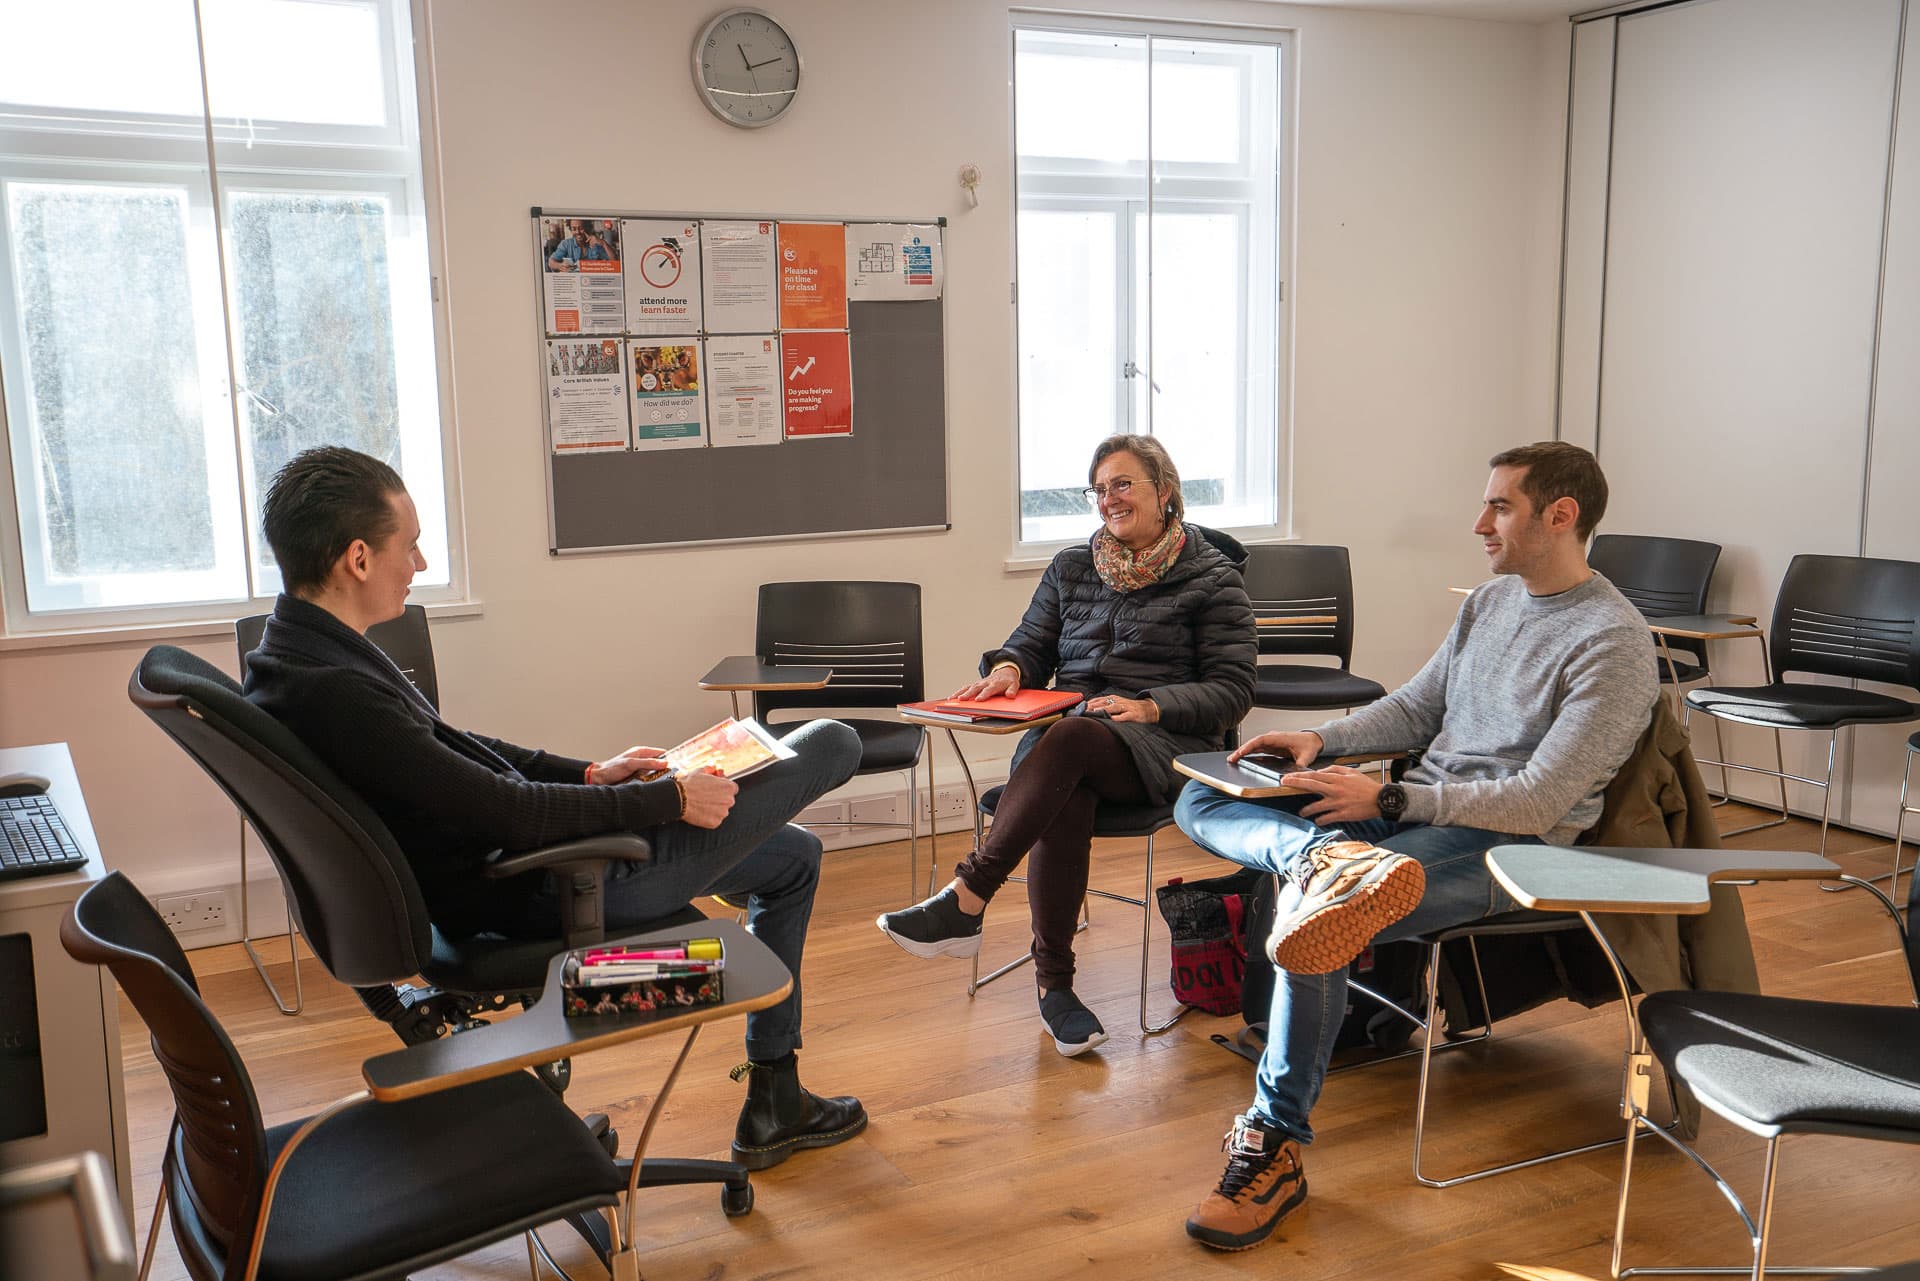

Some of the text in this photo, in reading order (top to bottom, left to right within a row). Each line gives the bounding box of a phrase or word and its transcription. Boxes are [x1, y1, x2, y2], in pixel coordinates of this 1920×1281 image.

[784, 266, 818, 275] Please be
[795, 275, 812, 283] time
[785, 283, 817, 291] for class!
[639, 297, 666, 305] attend
[641, 305, 687, 314] learn faster
[809, 387, 821, 395] feel
[659, 399, 670, 407] did
[799, 396, 822, 404] making
[788, 404, 819, 414] progress?
